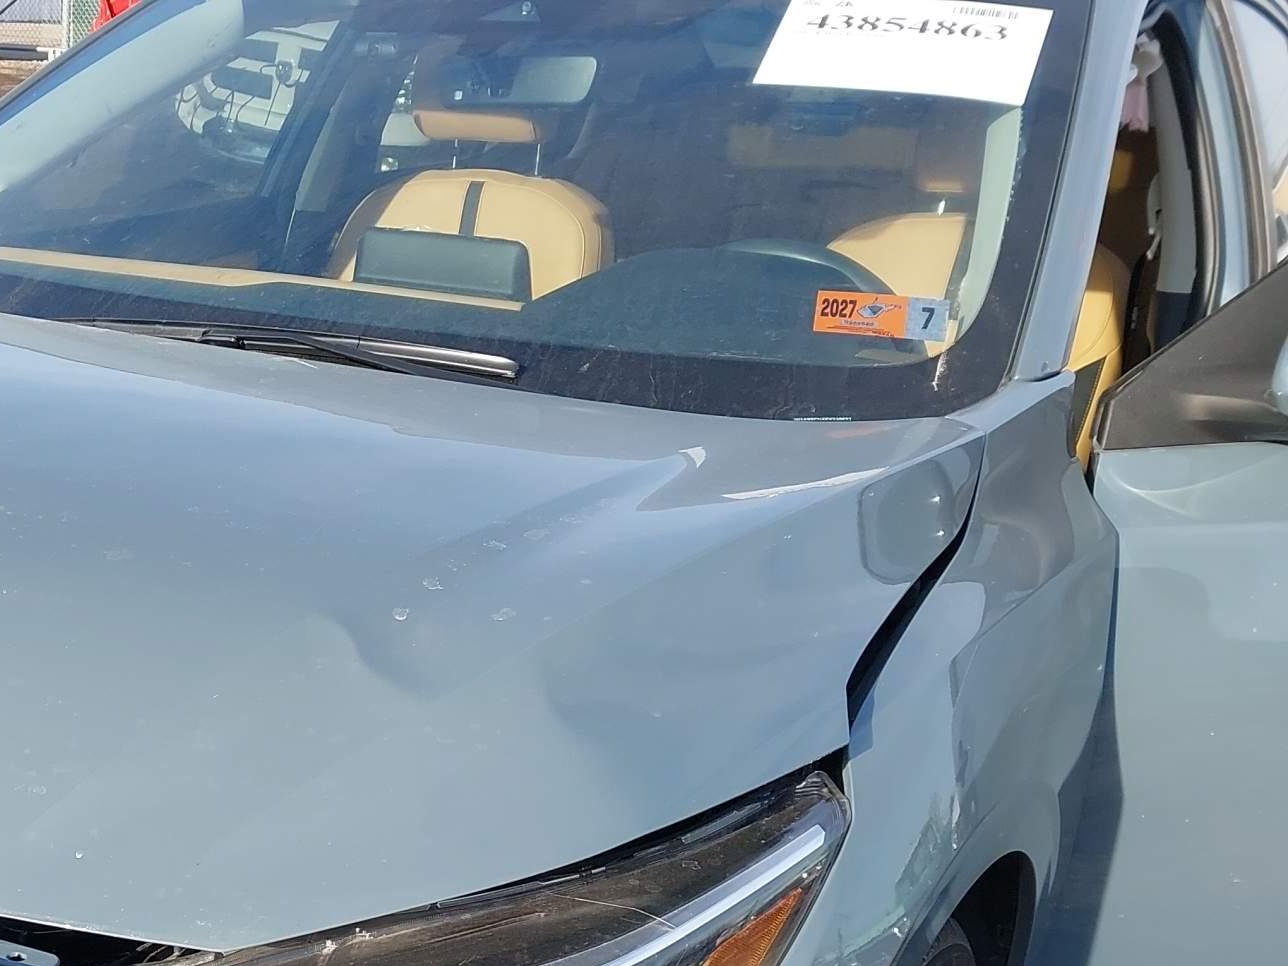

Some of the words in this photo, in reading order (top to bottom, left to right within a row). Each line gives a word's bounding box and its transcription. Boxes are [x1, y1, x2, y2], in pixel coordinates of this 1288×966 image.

[807, 13, 1008, 40] 43854863
[820, 298, 857, 319] 2027
[921, 306, 936, 330] 7
